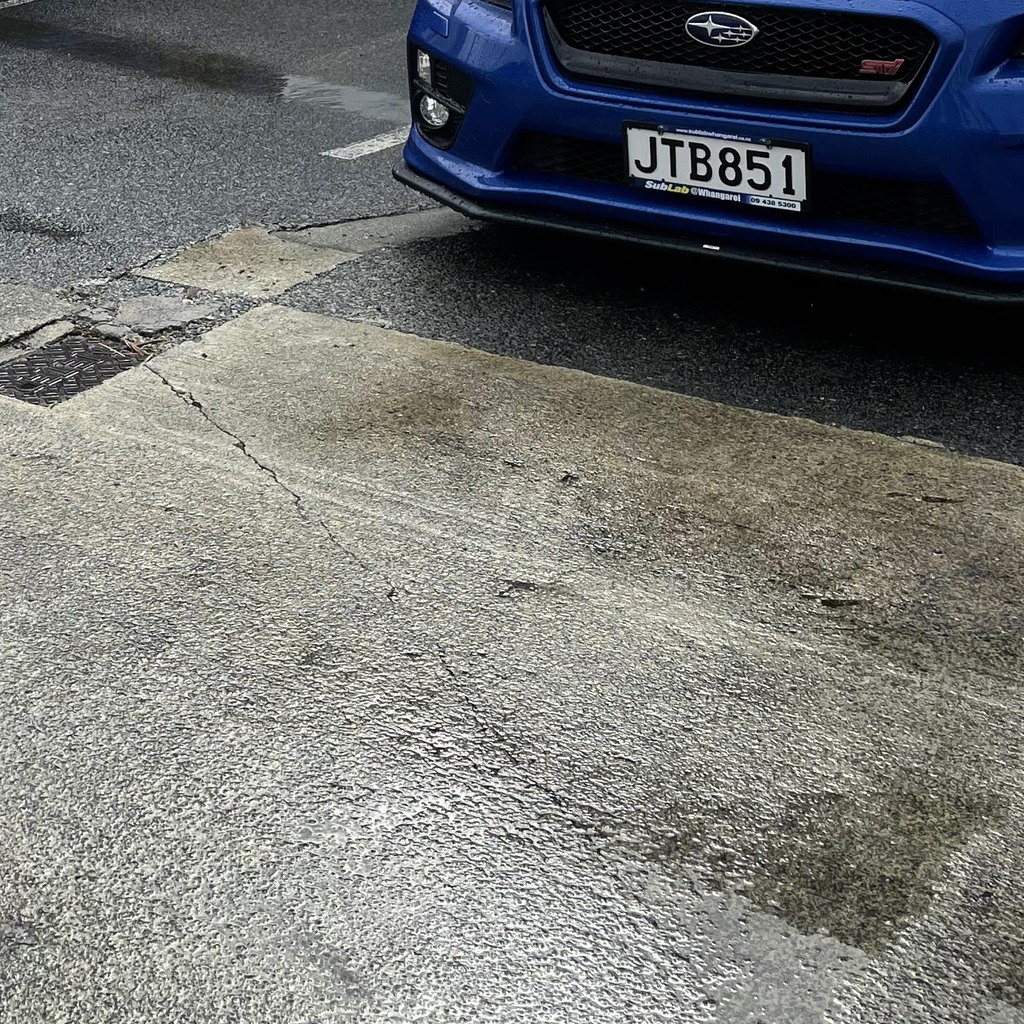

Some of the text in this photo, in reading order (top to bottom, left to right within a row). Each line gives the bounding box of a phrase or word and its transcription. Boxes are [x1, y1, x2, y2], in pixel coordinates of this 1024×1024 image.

[634, 136, 796, 196] JTB851
[644, 180, 690, 195] SubLab
[777, 201, 797, 209] 5300
